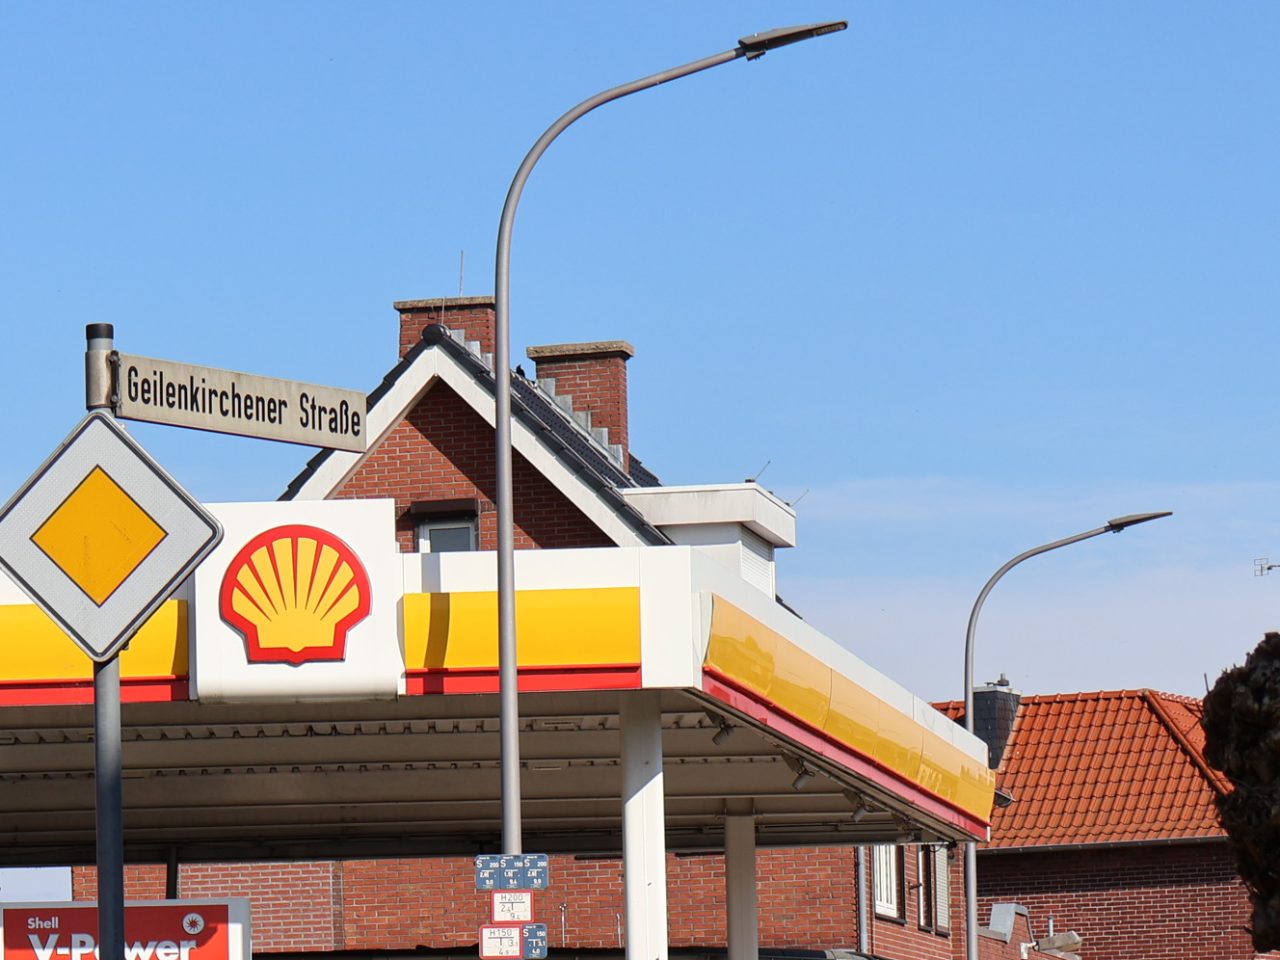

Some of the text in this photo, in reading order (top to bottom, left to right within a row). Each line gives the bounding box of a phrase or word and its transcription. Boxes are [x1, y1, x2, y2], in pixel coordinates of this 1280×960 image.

[127, 365, 361, 437] Geilenkirchener Straße
[27, 917, 59, 929] Shell
